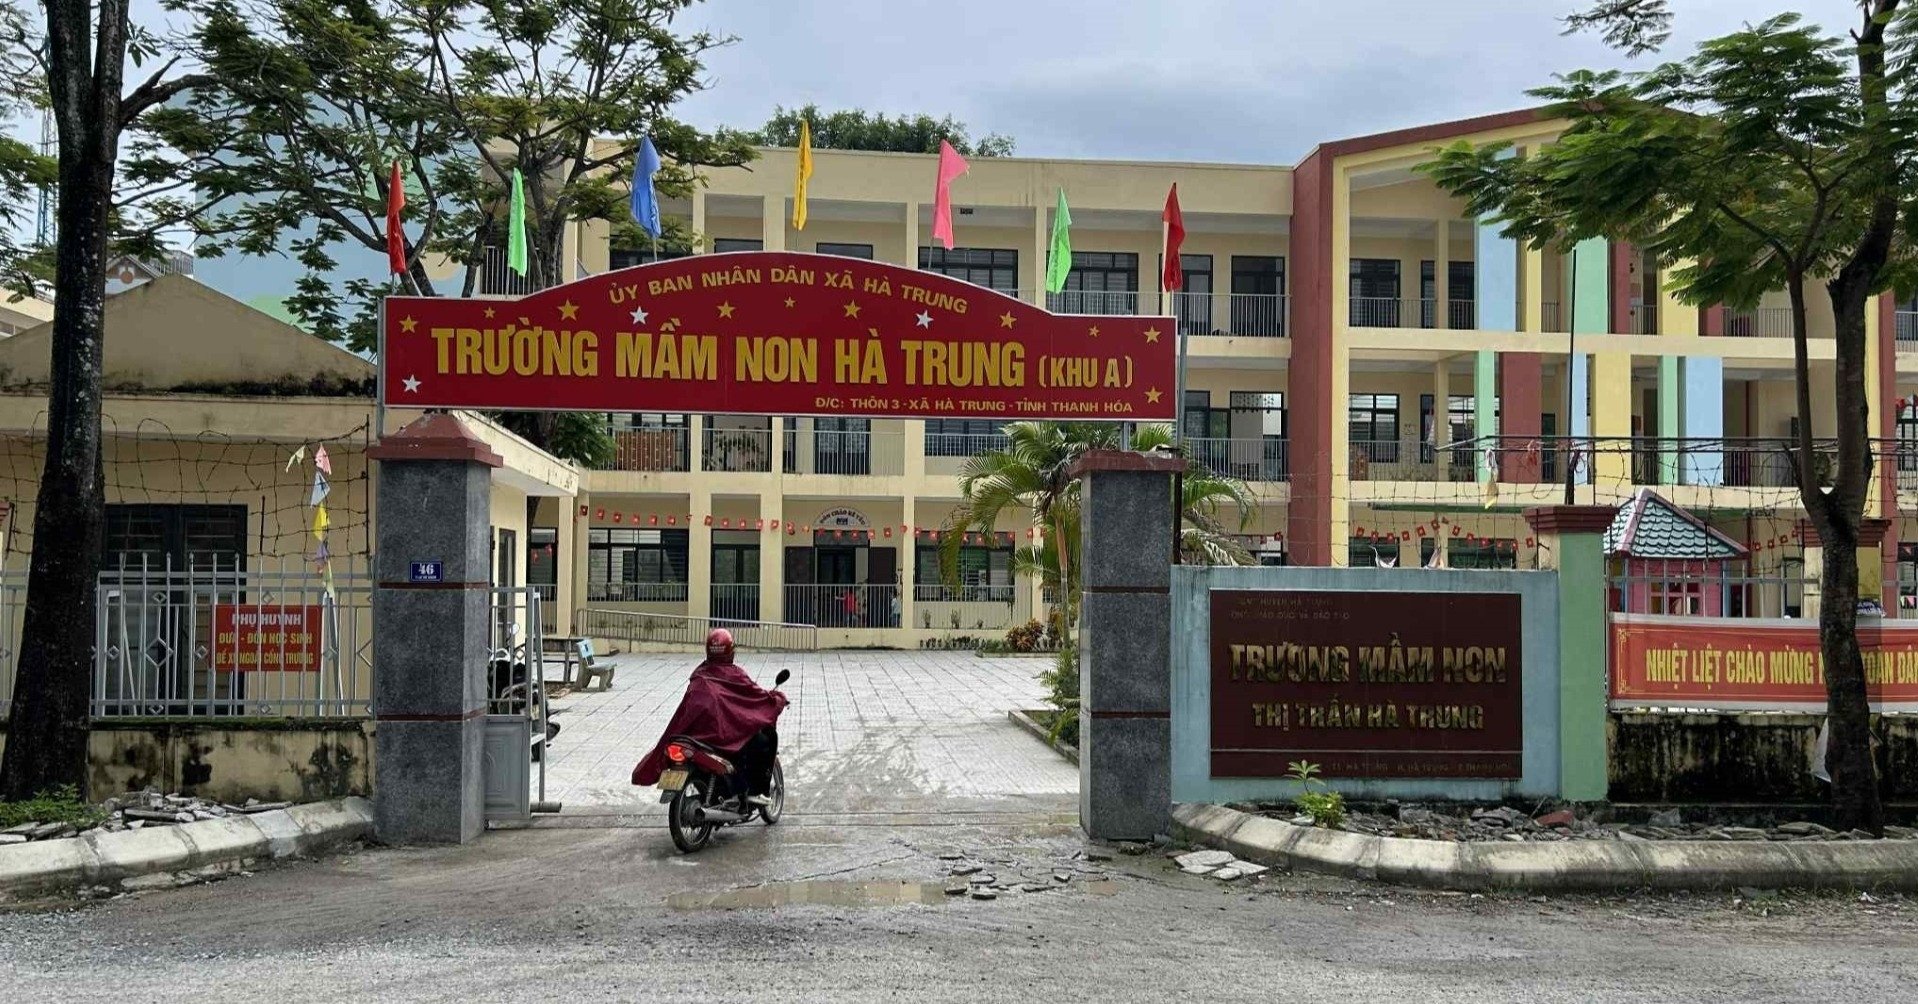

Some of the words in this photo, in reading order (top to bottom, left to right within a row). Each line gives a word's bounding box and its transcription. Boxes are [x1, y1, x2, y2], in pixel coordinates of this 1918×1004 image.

[609, 282, 639, 304] ỦY
[648, 274, 693, 295] BAN
[701, 266, 761, 287] NHÂN
[770, 266, 814, 285] DÂN
[824, 271, 854, 289] XÃ
[863, 276, 892, 296] HÀ
[901, 284, 968, 314] TRUNG
[431, 317, 599, 377] TRƯỜNG
[615, 318, 717, 381] MẦM
[736, 336, 817, 383] NON
[834, 328, 888, 384] HÀ
[900, 339, 1025, 387] TRUNG
[1038, 355, 1098, 388] (KHU
[1104, 355, 1133, 388] A)
[815, 397, 844, 409] Đ/C:
[850, 396, 888, 409] THÔN
[935, 397, 955, 410] HÀ
[959, 400, 1006, 411] TRUNG
[1051, 401, 1099, 413] THANH
[1104, 400, 1133, 413] HÓA
[418, 563, 435, 575] 46
[1442, 646, 1507, 683] NON
[1646, 642, 1688, 690] NHIỆT
[1692, 642, 1722, 690] LIỆT
[1726, 644, 1765, 684] CHÀO
[1770, 644, 1813, 684] MỪNG
[1252, 703, 1290, 731] THỊ
[1367, 700, 1400, 729] HÀ
[1405, 704, 1485, 729] TRUNG
